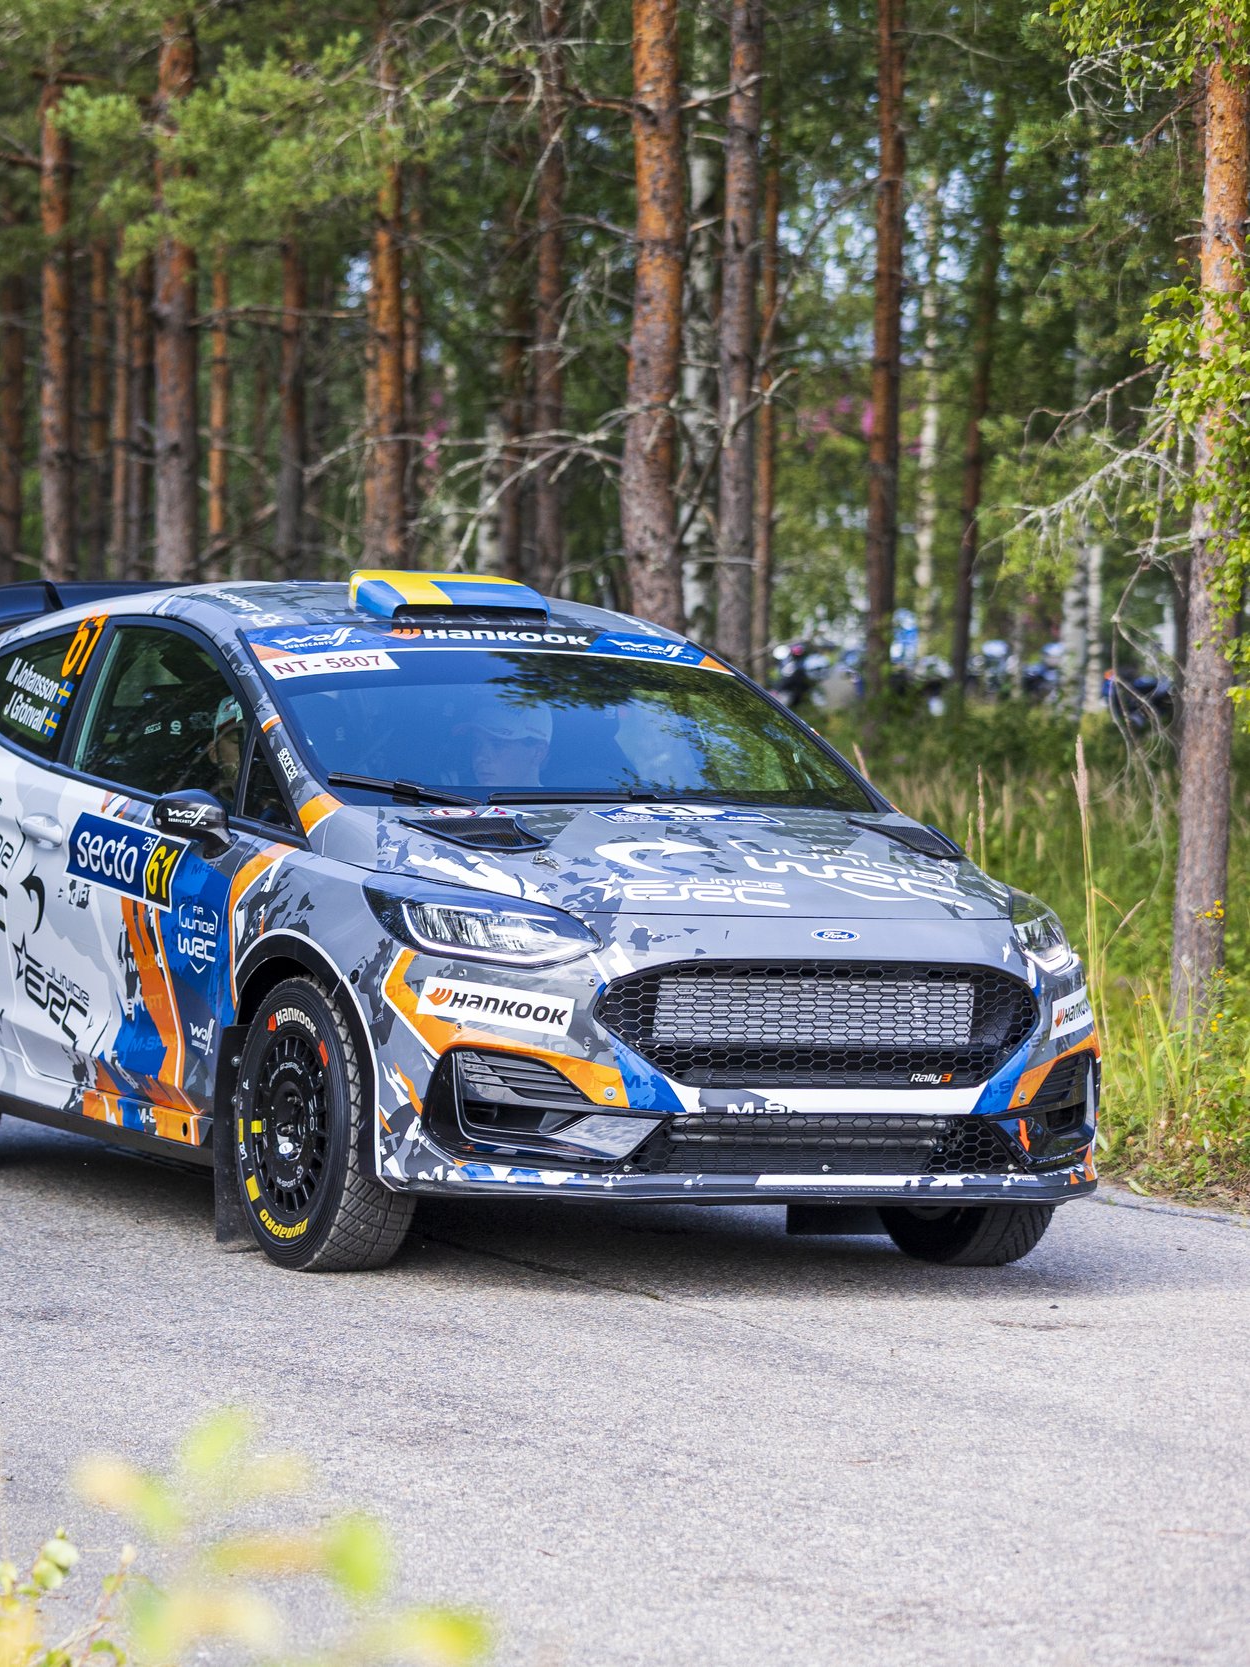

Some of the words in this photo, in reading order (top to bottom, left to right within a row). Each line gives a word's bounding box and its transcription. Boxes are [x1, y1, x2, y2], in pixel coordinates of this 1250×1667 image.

[61, 609, 110, 678] 61
[13, 661, 60, 703] Johansson
[3, 691, 18, 716] J
[9, 693, 50, 732] Grönvall
[76, 830, 139, 884] secto
[146, 845, 179, 899] 61
[672, 876, 785, 891] JUNIOR
[192, 905, 204, 916] FIA
[180, 917, 216, 936] JUNIOR
[821, 930, 851, 941] Ford
[177, 933, 217, 963] WRC
[45, 966, 90, 1007] JUNIOR
[910, 1073, 953, 1085] Rally3
